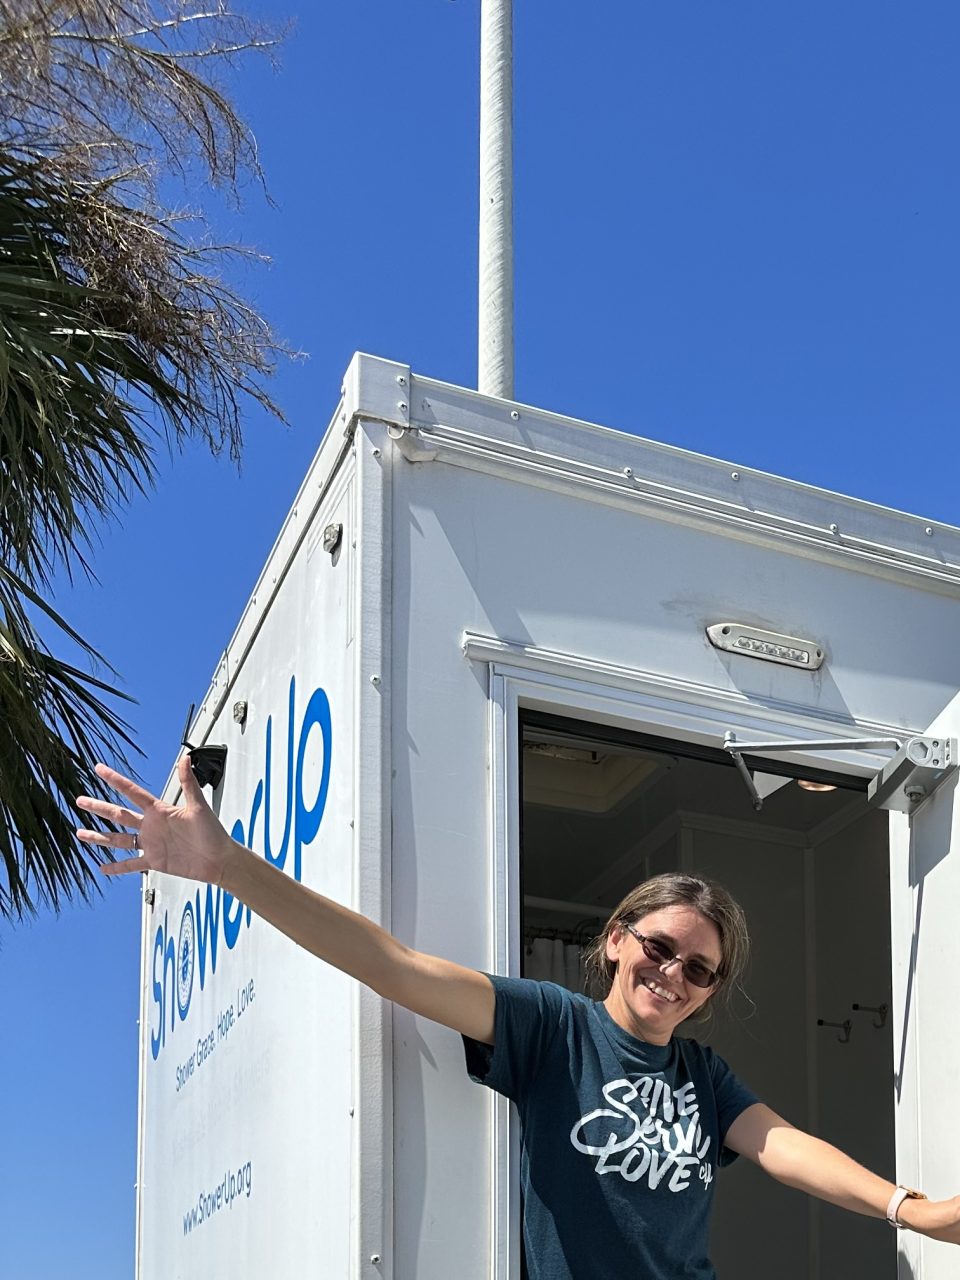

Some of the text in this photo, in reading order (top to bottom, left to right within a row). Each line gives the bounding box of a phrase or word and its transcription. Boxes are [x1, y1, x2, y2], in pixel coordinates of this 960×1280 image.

[176, 1052, 196, 1093] Shower
[217, 1004, 236, 1042] Hope.
[237, 978, 256, 1018] Love.
[182, 1160, 252, 1237] www.ShowerUp.org
[595, 1133, 700, 1193] LOVE
